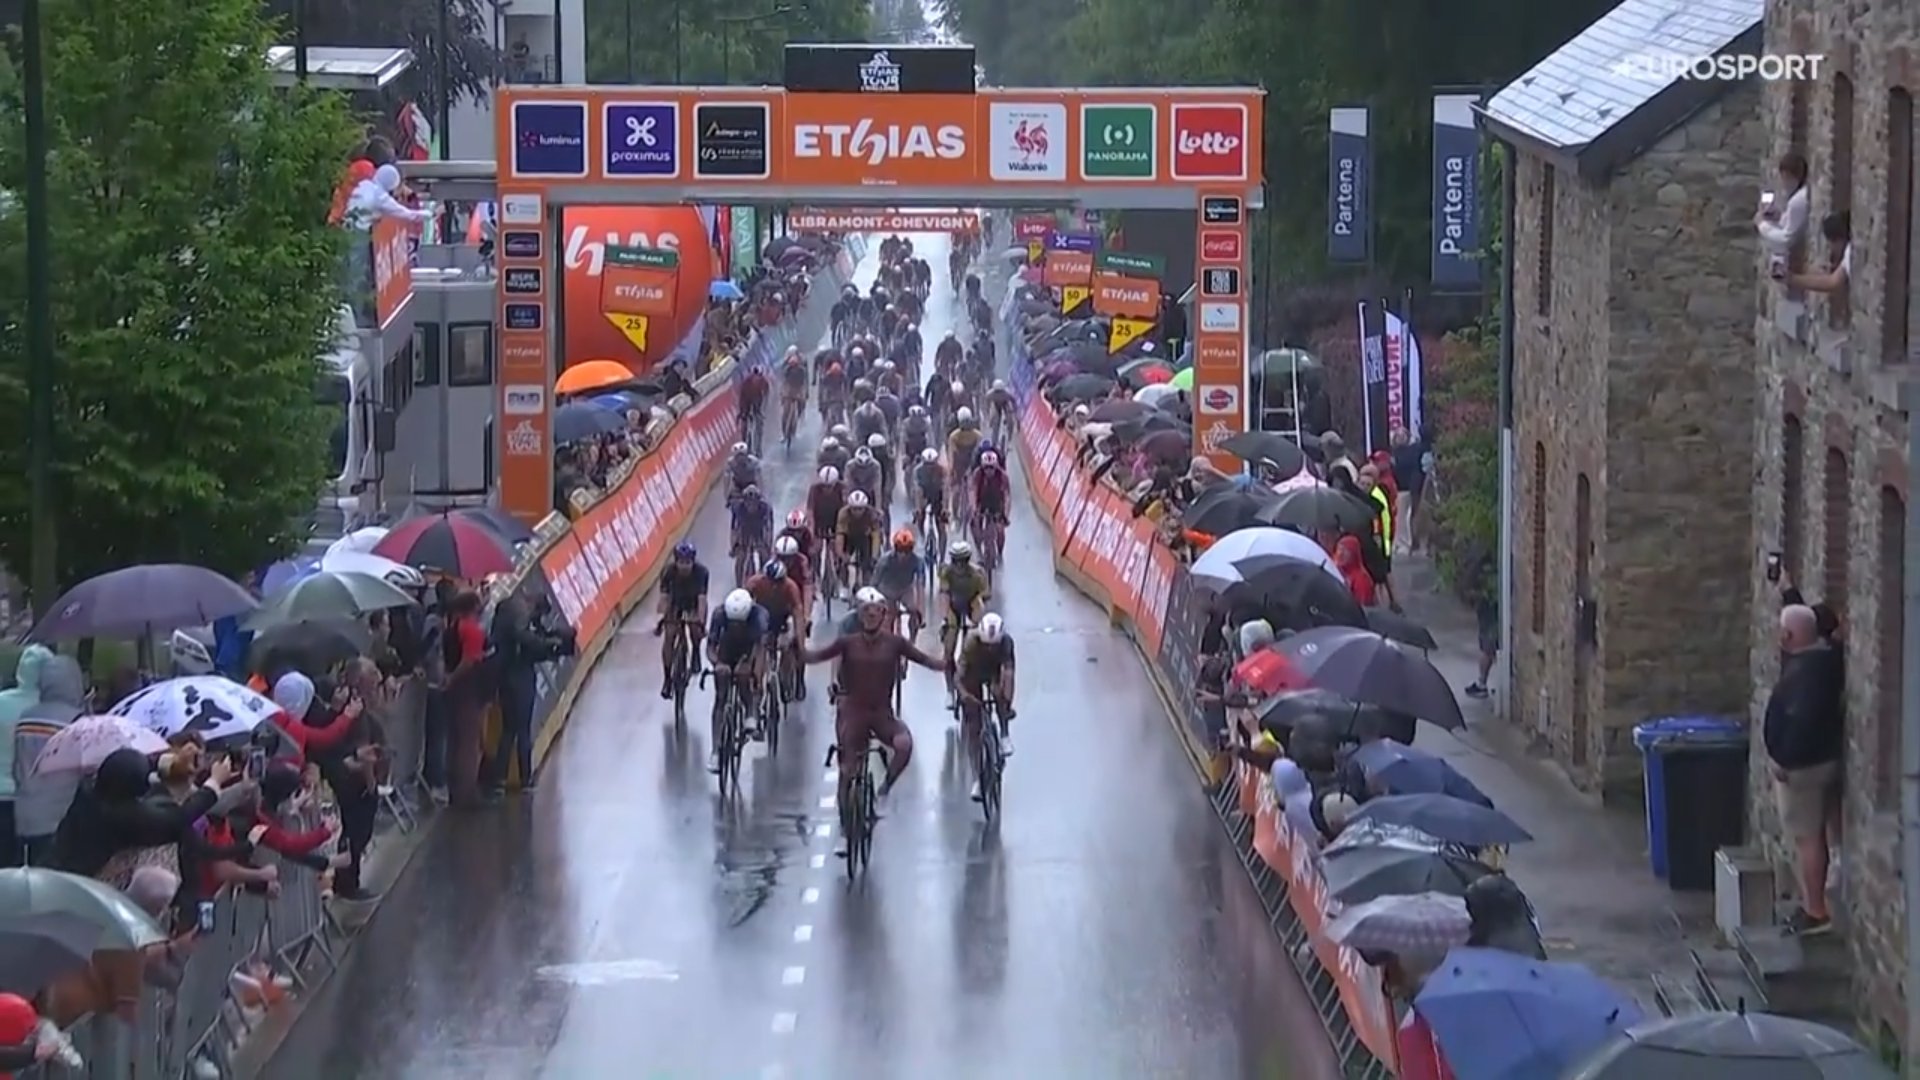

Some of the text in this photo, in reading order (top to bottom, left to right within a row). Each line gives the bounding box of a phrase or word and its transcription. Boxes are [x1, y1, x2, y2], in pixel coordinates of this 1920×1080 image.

[539, 134, 581, 145] luminus
[611, 151, 671, 164] proximus
[1088, 152, 1149, 161] PANORAMA
[1334, 157, 1353, 235] Partena
[1439, 156, 1463, 255] Partena
[791, 216, 975, 229] LIBRAMONT-CHEVIGNY
[625, 318, 642, 331] 25
[1116, 323, 1132, 337] 25
